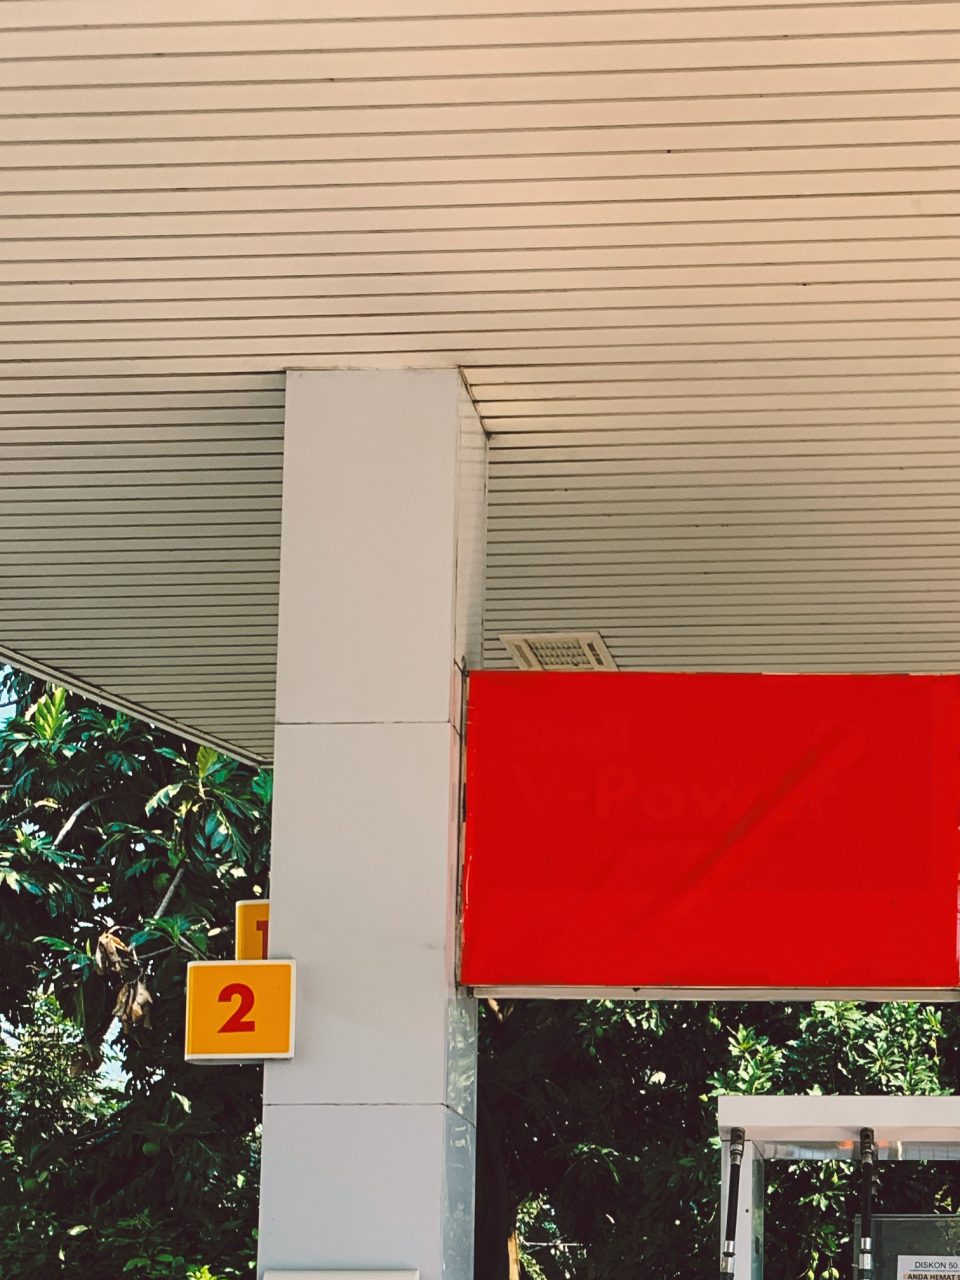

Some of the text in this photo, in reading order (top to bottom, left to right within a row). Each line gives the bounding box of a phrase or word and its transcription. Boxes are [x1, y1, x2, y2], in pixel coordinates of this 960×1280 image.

[511, 766, 823, 821] V-Powr
[217, 983, 256, 1034] 2
[914, 1261, 947, 1269] DISKON
[929, 1273, 955, 1280] HEMAT
